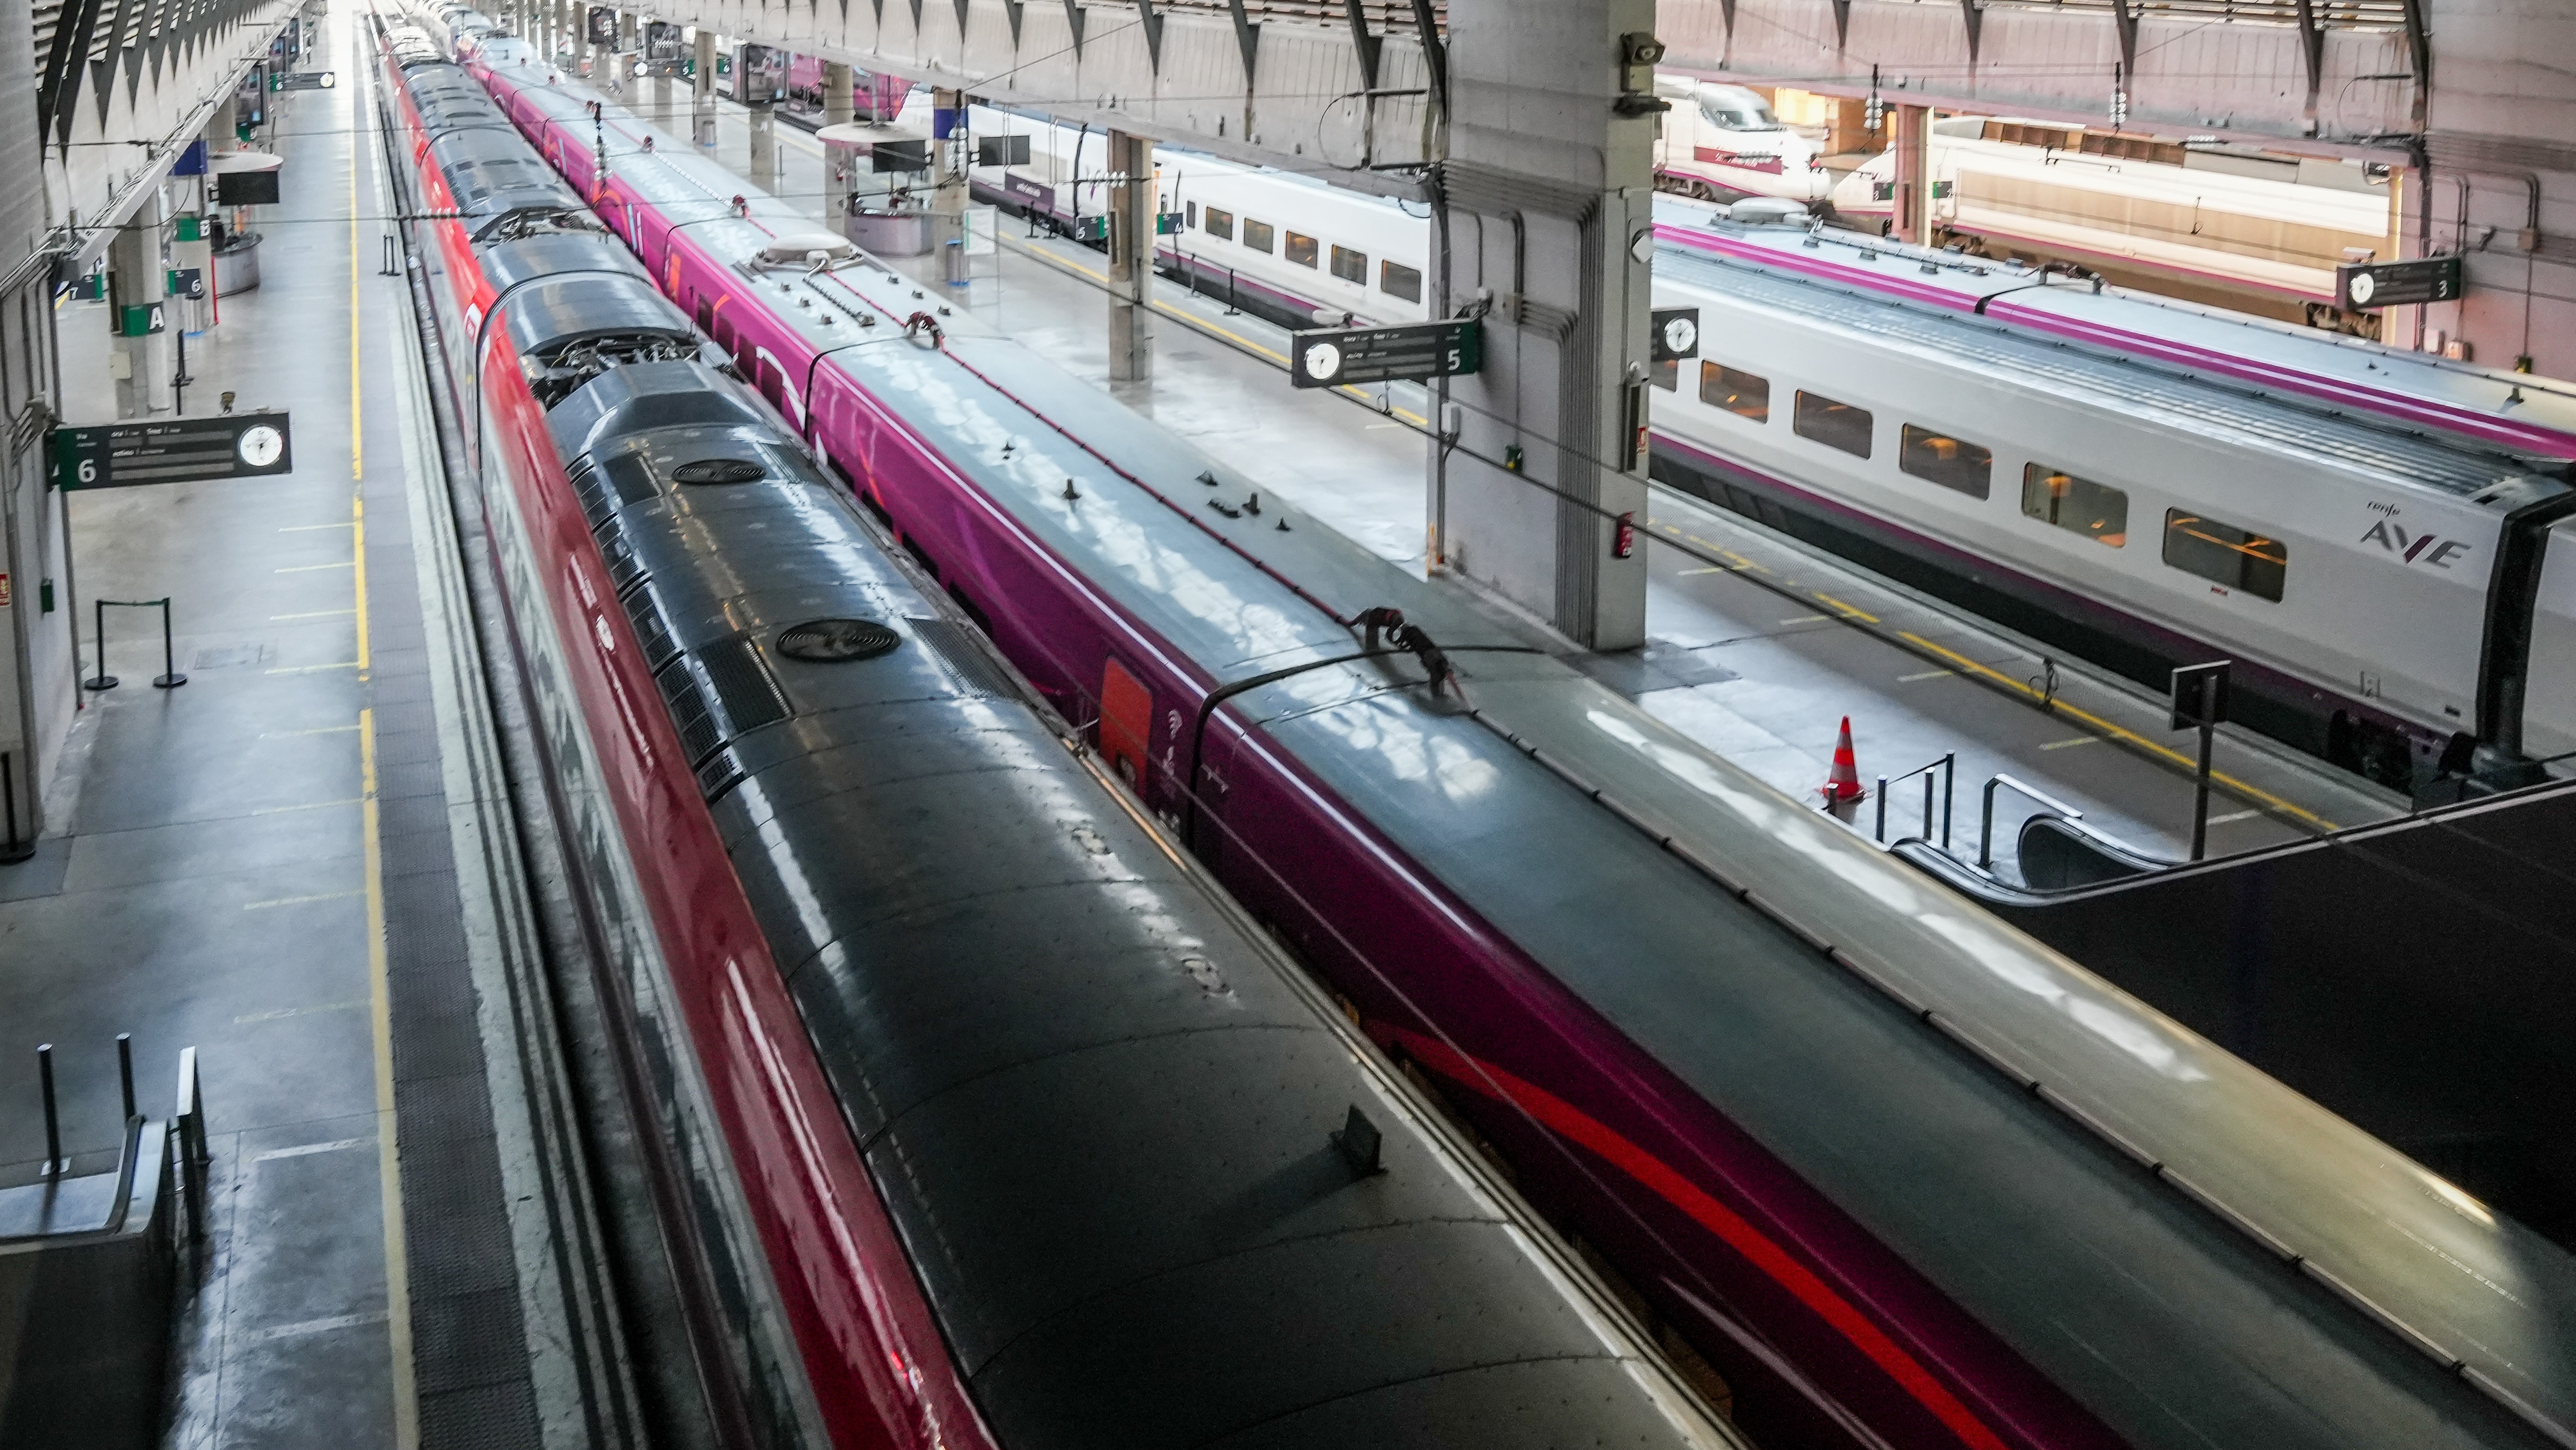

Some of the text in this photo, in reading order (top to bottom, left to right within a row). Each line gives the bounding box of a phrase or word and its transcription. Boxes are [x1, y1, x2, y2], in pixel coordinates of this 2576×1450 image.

[69, 287, 79, 300] 7
[191, 279, 201, 292] 6
[2438, 280, 2448, 298] 3
[149, 307, 165, 330] A
[1448, 348, 1461, 371] 5
[77, 459, 97, 483] 6
[2367, 500, 2401, 518] renfe
[2360, 520, 2473, 569] AVE
